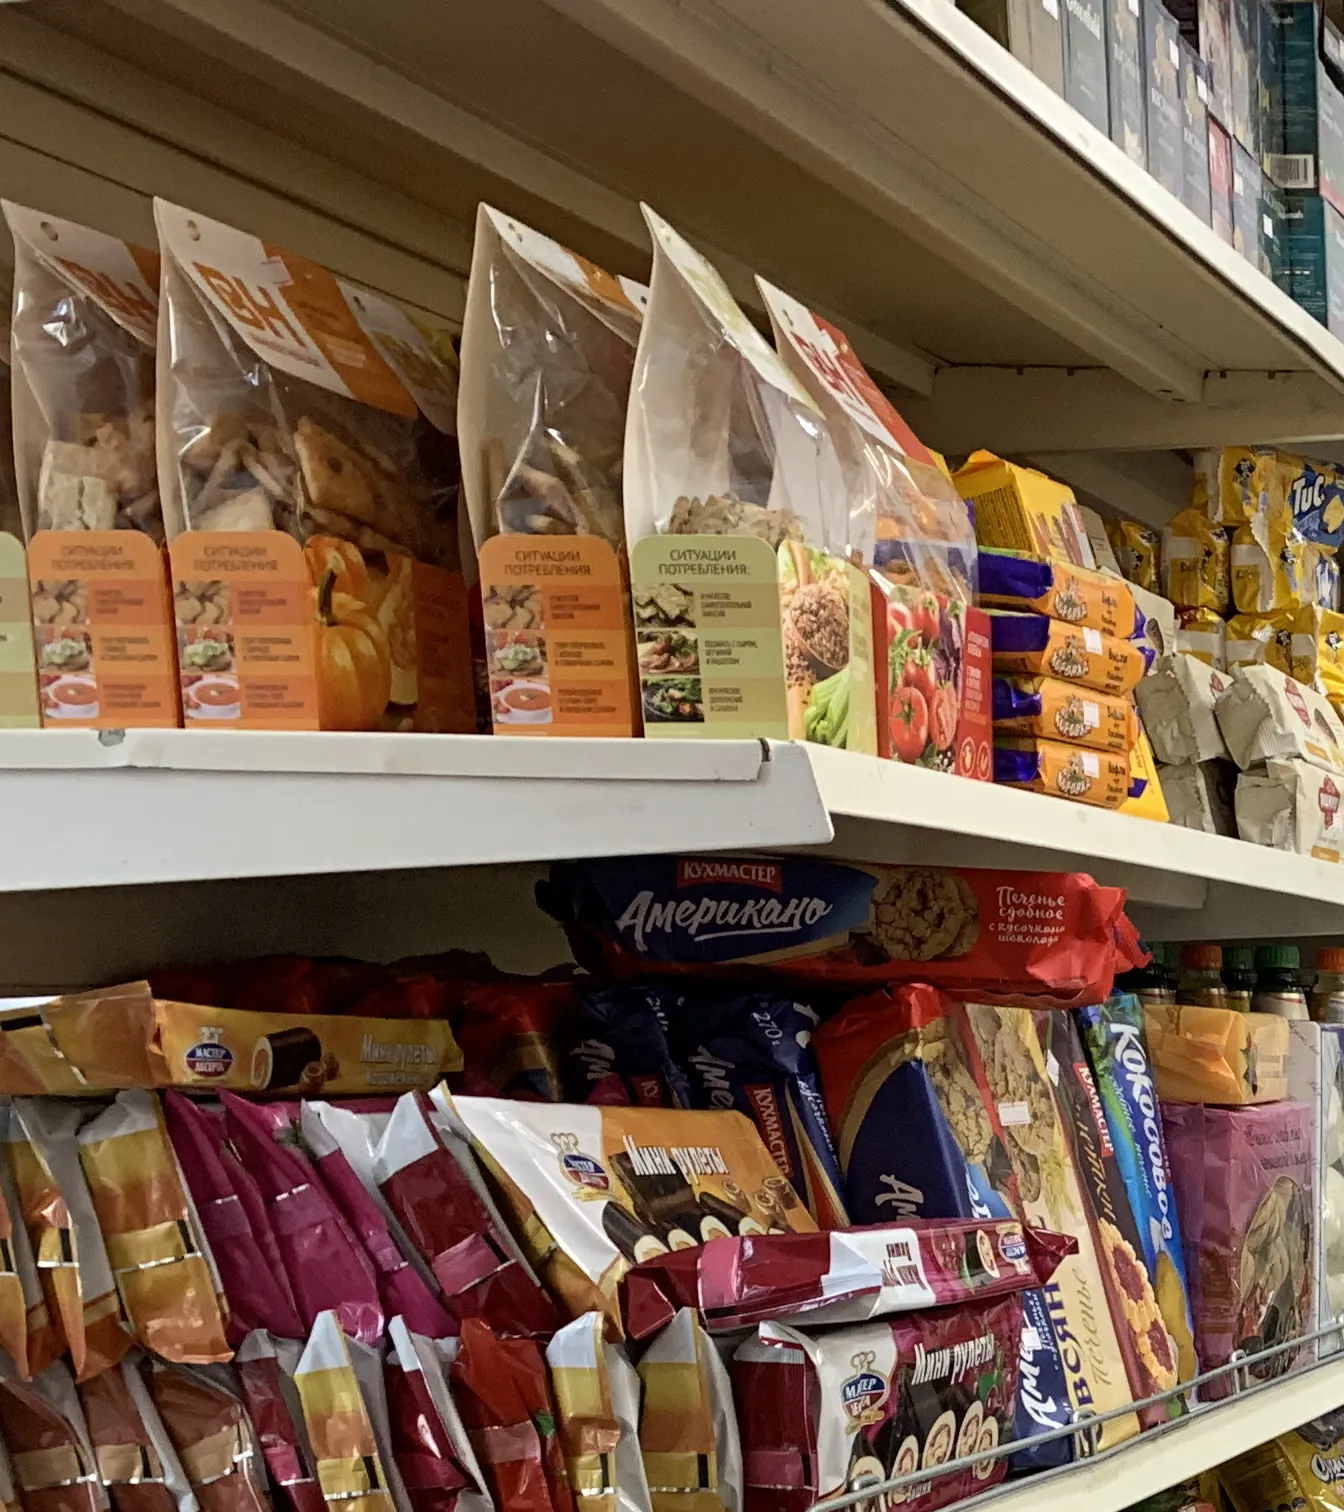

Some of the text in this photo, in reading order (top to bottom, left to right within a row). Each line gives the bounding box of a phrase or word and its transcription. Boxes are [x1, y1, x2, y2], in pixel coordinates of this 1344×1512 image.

[514, 550, 581, 562] СИТУАЦИИ
[670, 550, 737, 562] СИТУАЦИИ
[683, 861, 777, 884] КУХМАСТЕР
[996, 886, 1065, 907] Печенье
[999, 904, 1063, 922] сдобное
[615, 890, 834, 951] Американо
[1077, 1064, 1113, 1154] КУХМАСТЕР
[1109, 1022, 1173, 1242] Кокосовое
[622, 1134, 730, 1186] Мини рулеты
[911, 1332, 996, 1386] Мини рулеты
